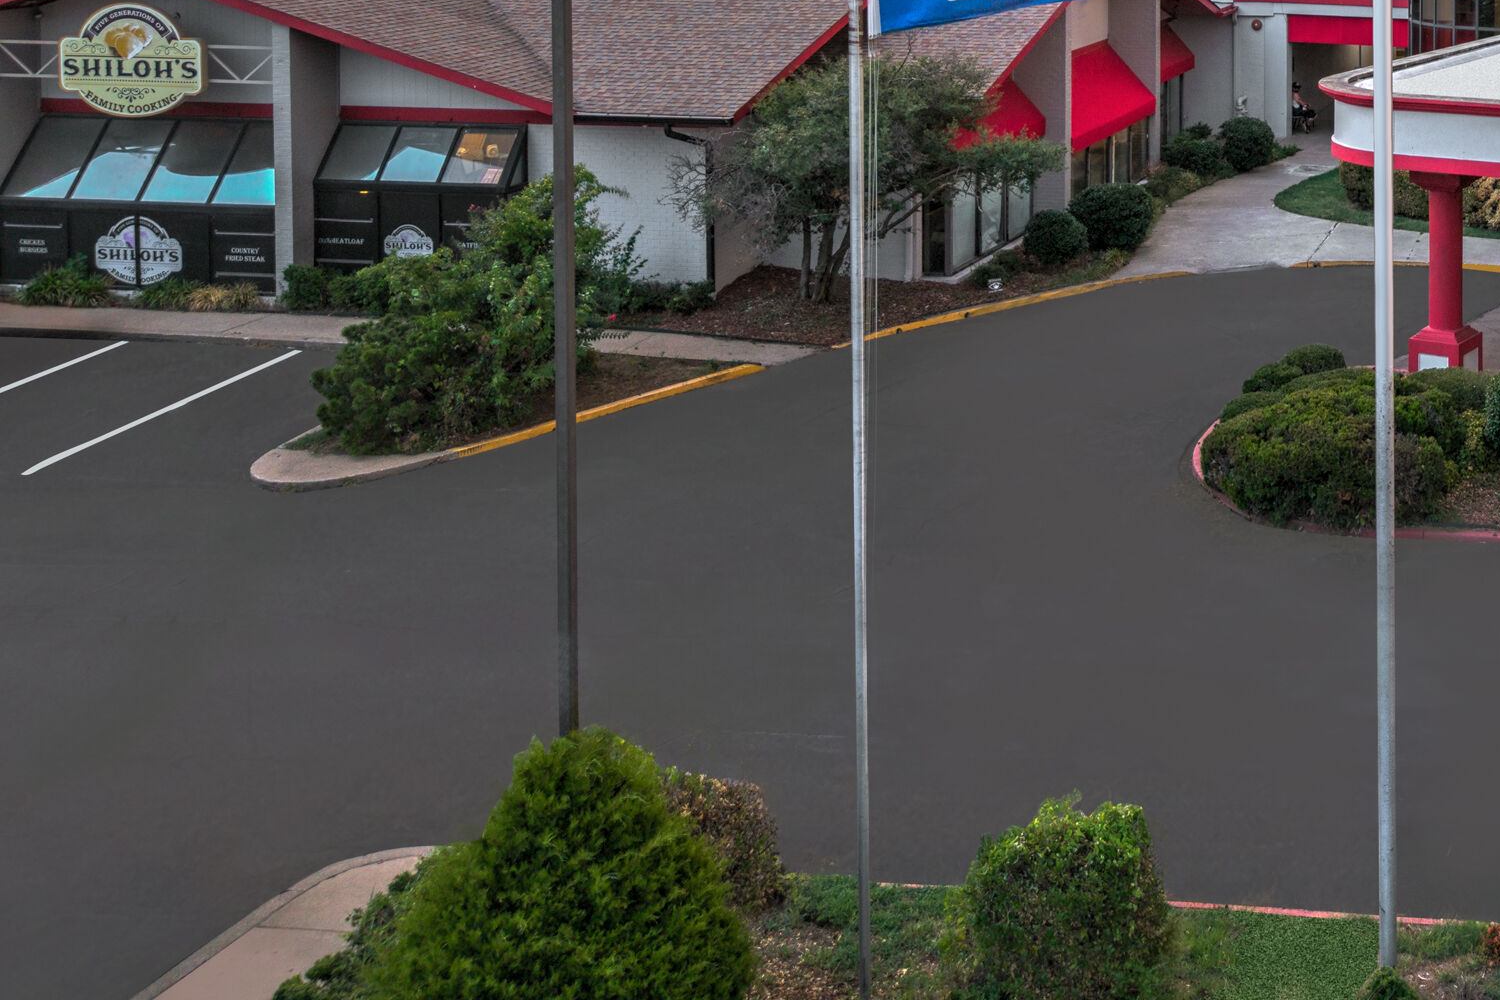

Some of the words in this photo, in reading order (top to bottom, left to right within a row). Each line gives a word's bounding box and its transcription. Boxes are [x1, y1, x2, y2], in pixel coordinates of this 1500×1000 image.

[94, 16, 109, 31] FIVE
[109, 9, 155, 24] GENERATIONS
[155, 22, 165, 32] OF
[63, 58, 198, 79] SHILOH'S
[85, 91, 125, 113] FAMILY
[127, 93, 178, 114] COOKING
[97, 248, 180, 263] SHILOH'S
[231, 247, 260, 255] COUNTRY
